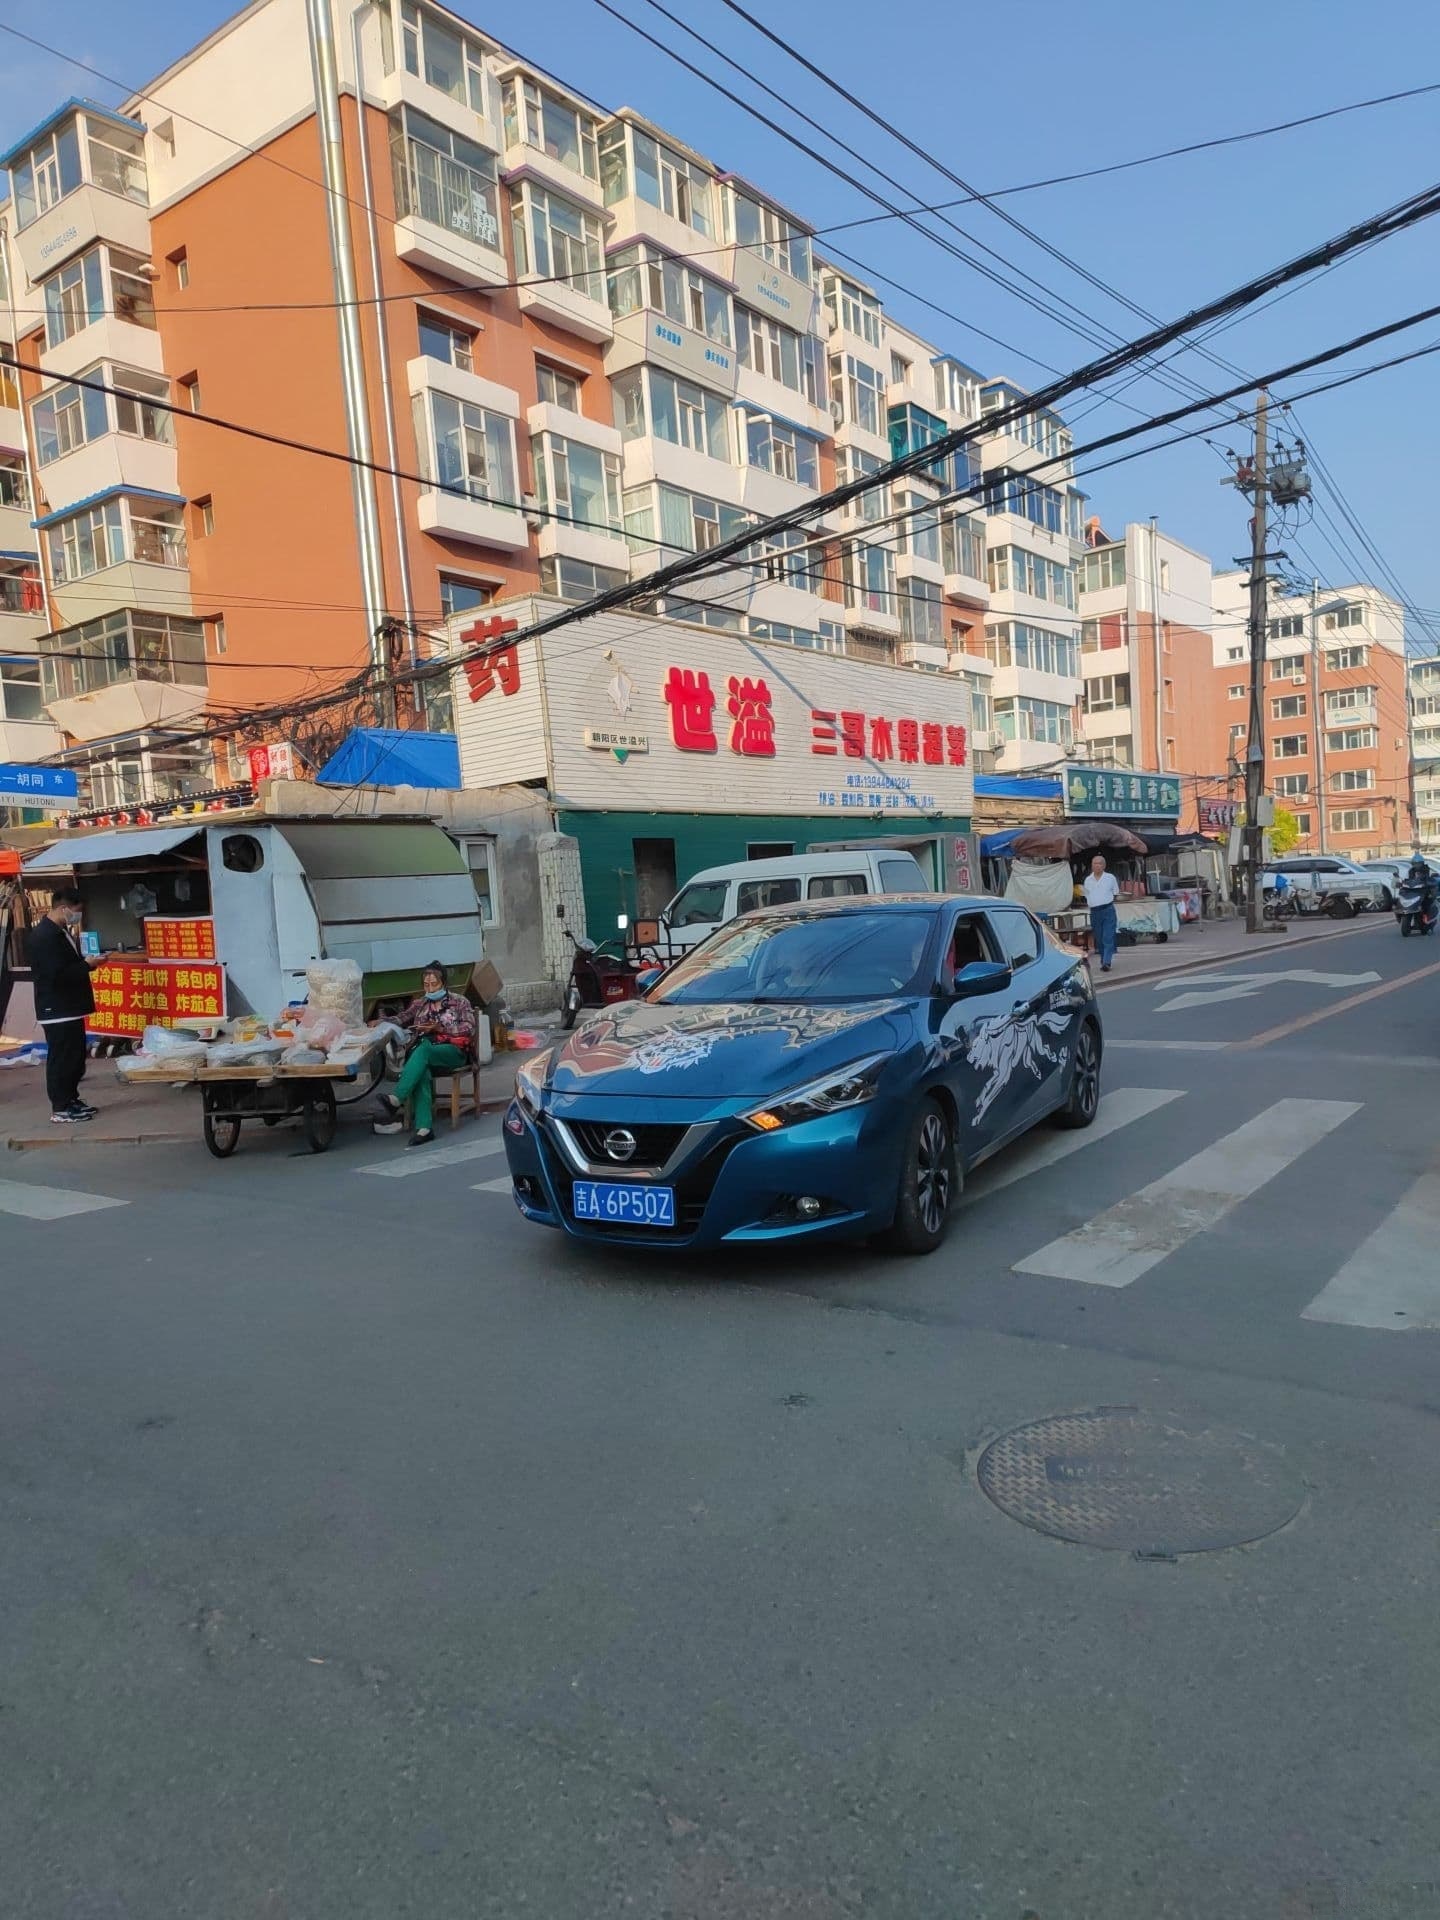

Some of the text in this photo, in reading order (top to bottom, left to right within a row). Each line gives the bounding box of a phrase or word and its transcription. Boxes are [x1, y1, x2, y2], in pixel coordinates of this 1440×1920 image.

[460, 616, 521, 704] 药
[663, 666, 966, 767] 世溢 三哥水果蔬菜
[53, 775, 64, 785] 东
[24, 798, 56, 806] HUTONG
[130, 968, 168, 987] 手抓饼
[176, 970, 218, 990] 锅包肉
[130, 991, 169, 1010] 大鱿鱼
[176, 994, 219, 1014] 炸茄盒
